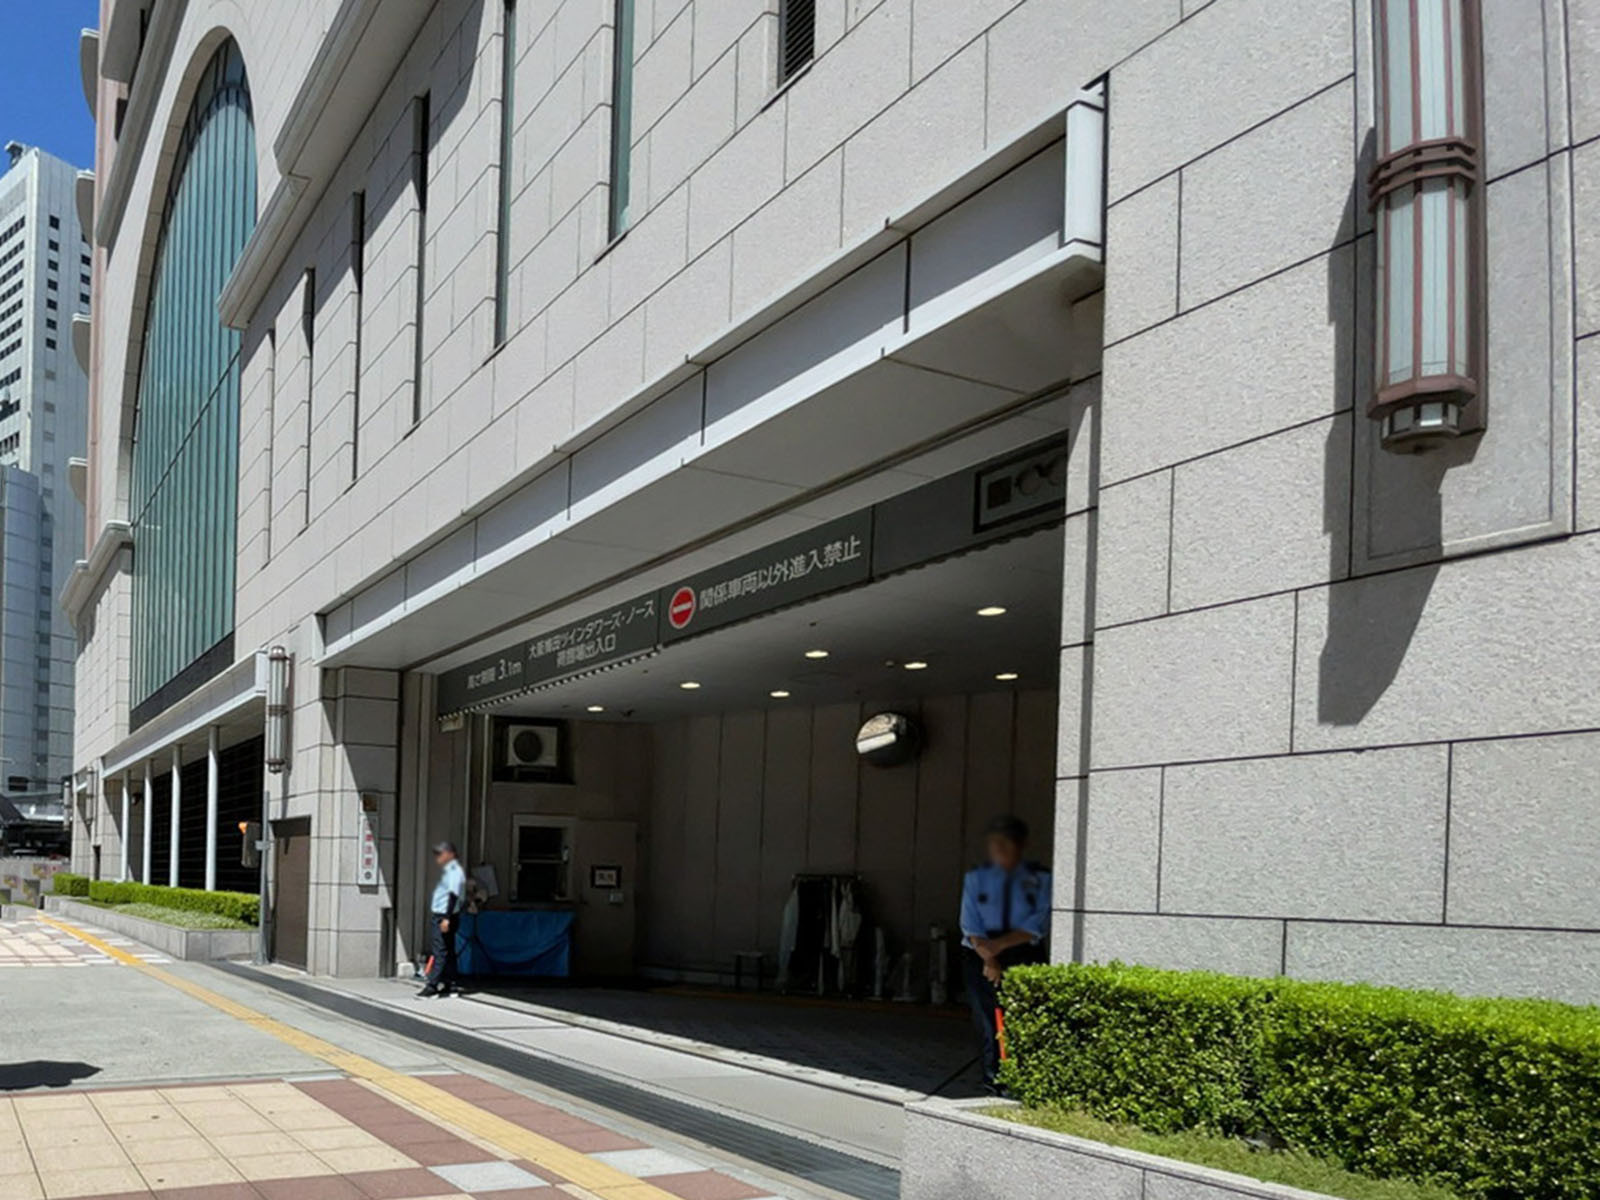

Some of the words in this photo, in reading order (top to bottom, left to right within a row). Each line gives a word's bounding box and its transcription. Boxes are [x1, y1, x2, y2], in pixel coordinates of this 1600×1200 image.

[699, 535, 862, 611] 関係車両以外進入禁止
